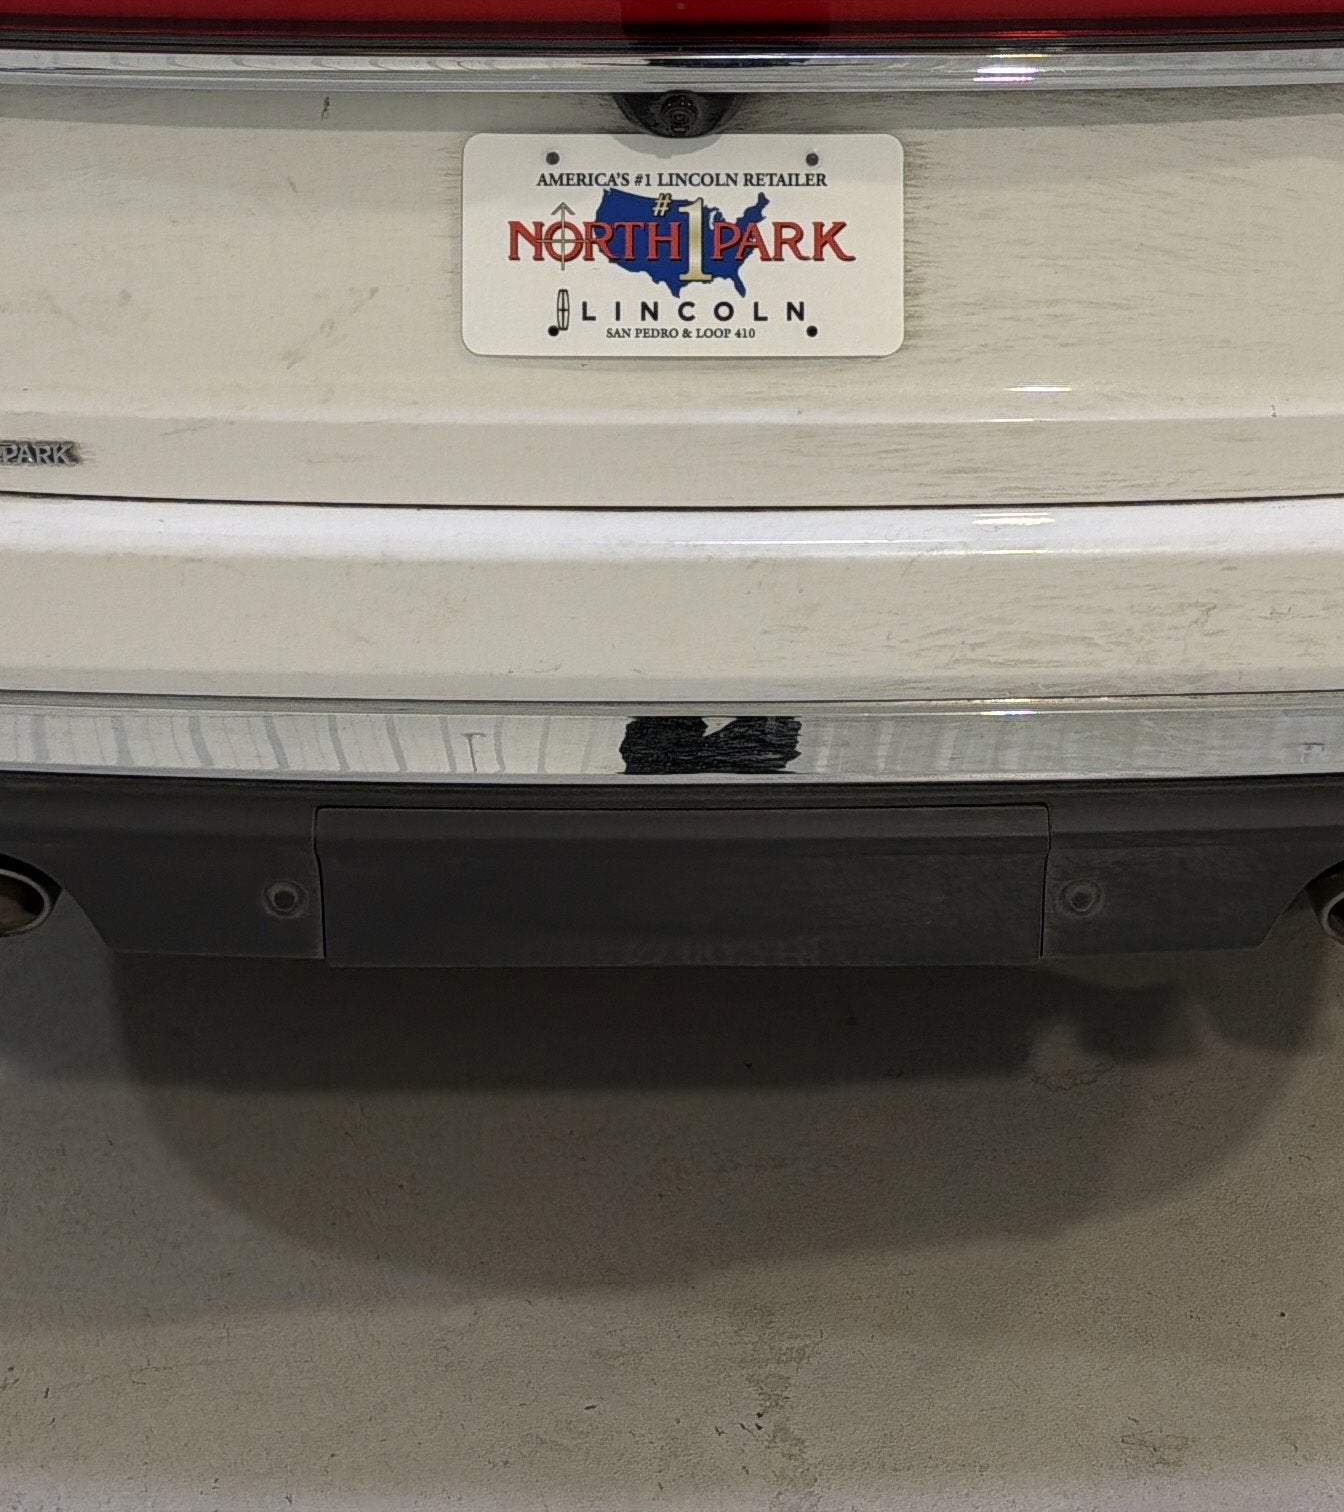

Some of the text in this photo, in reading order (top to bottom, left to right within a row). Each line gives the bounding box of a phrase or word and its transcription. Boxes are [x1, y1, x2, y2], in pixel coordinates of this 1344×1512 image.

[536, 172, 828, 187] AMERICA'S #1 LINCOLN RETAILER
[508, 220, 856, 261] NORTH PARK
[581, 301, 806, 322] LINCOLN
[605, 327, 756, 339] SAN PEDRO & LOOP 410
